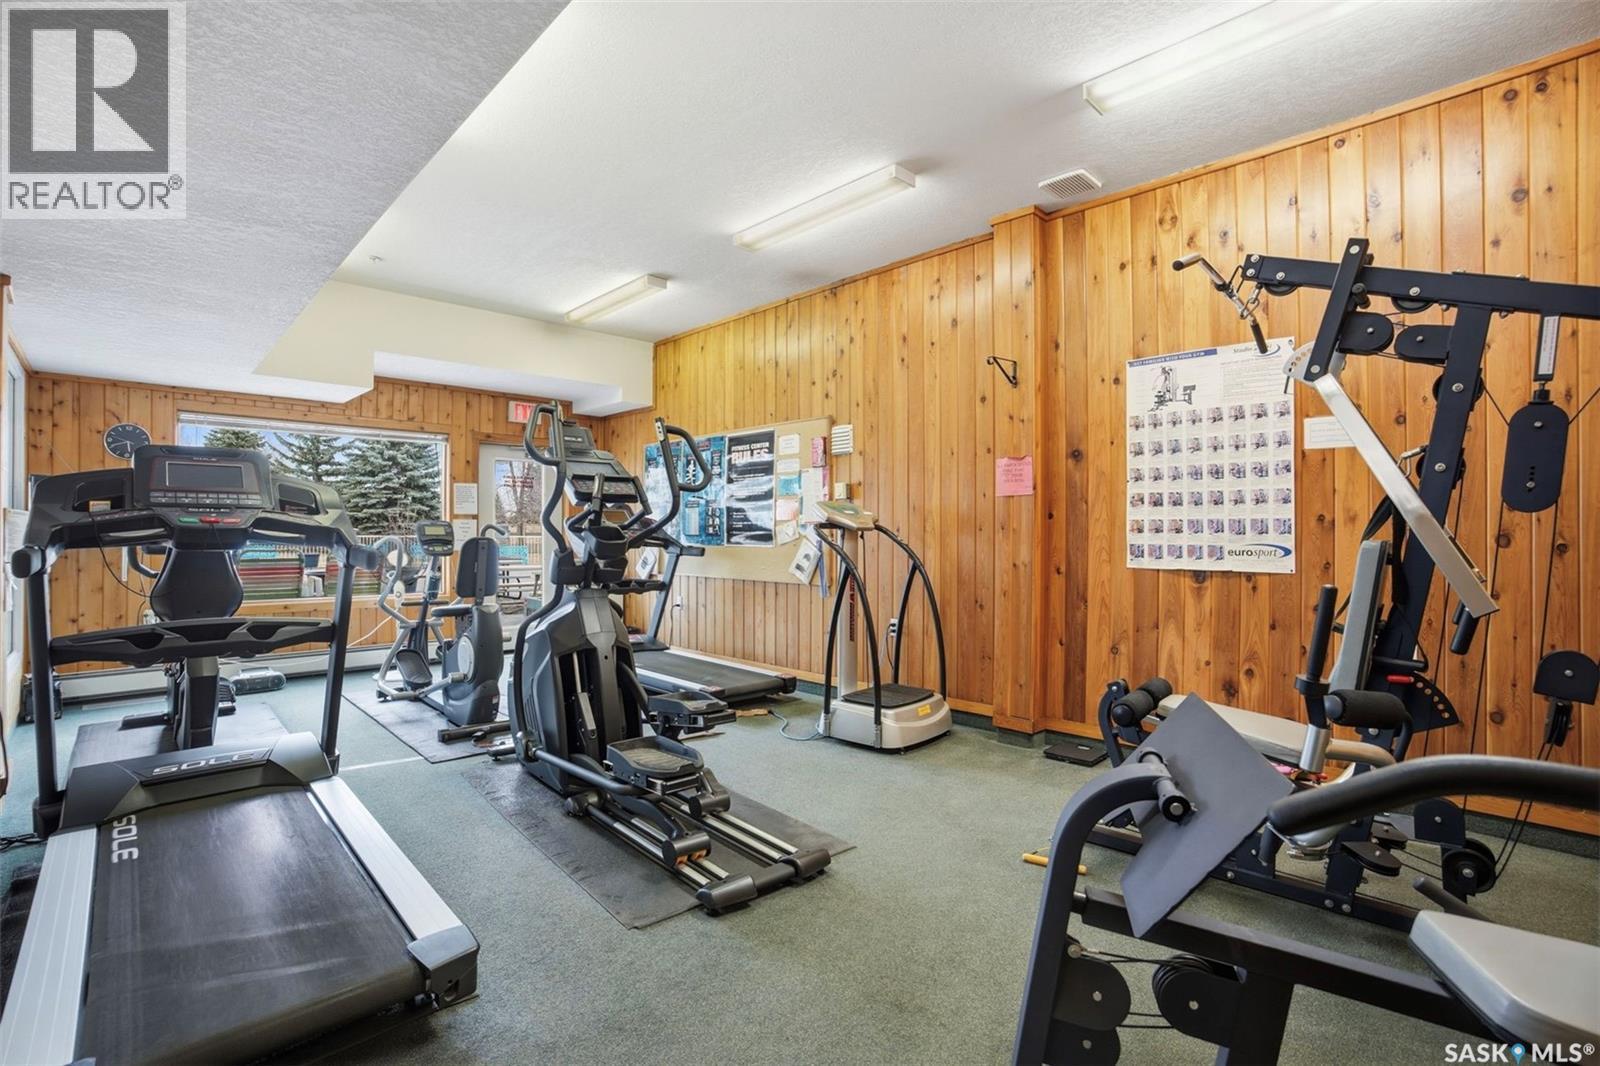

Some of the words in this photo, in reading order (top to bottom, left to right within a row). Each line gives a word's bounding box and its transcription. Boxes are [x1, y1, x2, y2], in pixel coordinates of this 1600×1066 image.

[731, 448, 769, 465] RULES
[1227, 547, 1278, 561] eurosport
[152, 753, 254, 776] SOLE
[111, 814, 139, 863] SOLE
